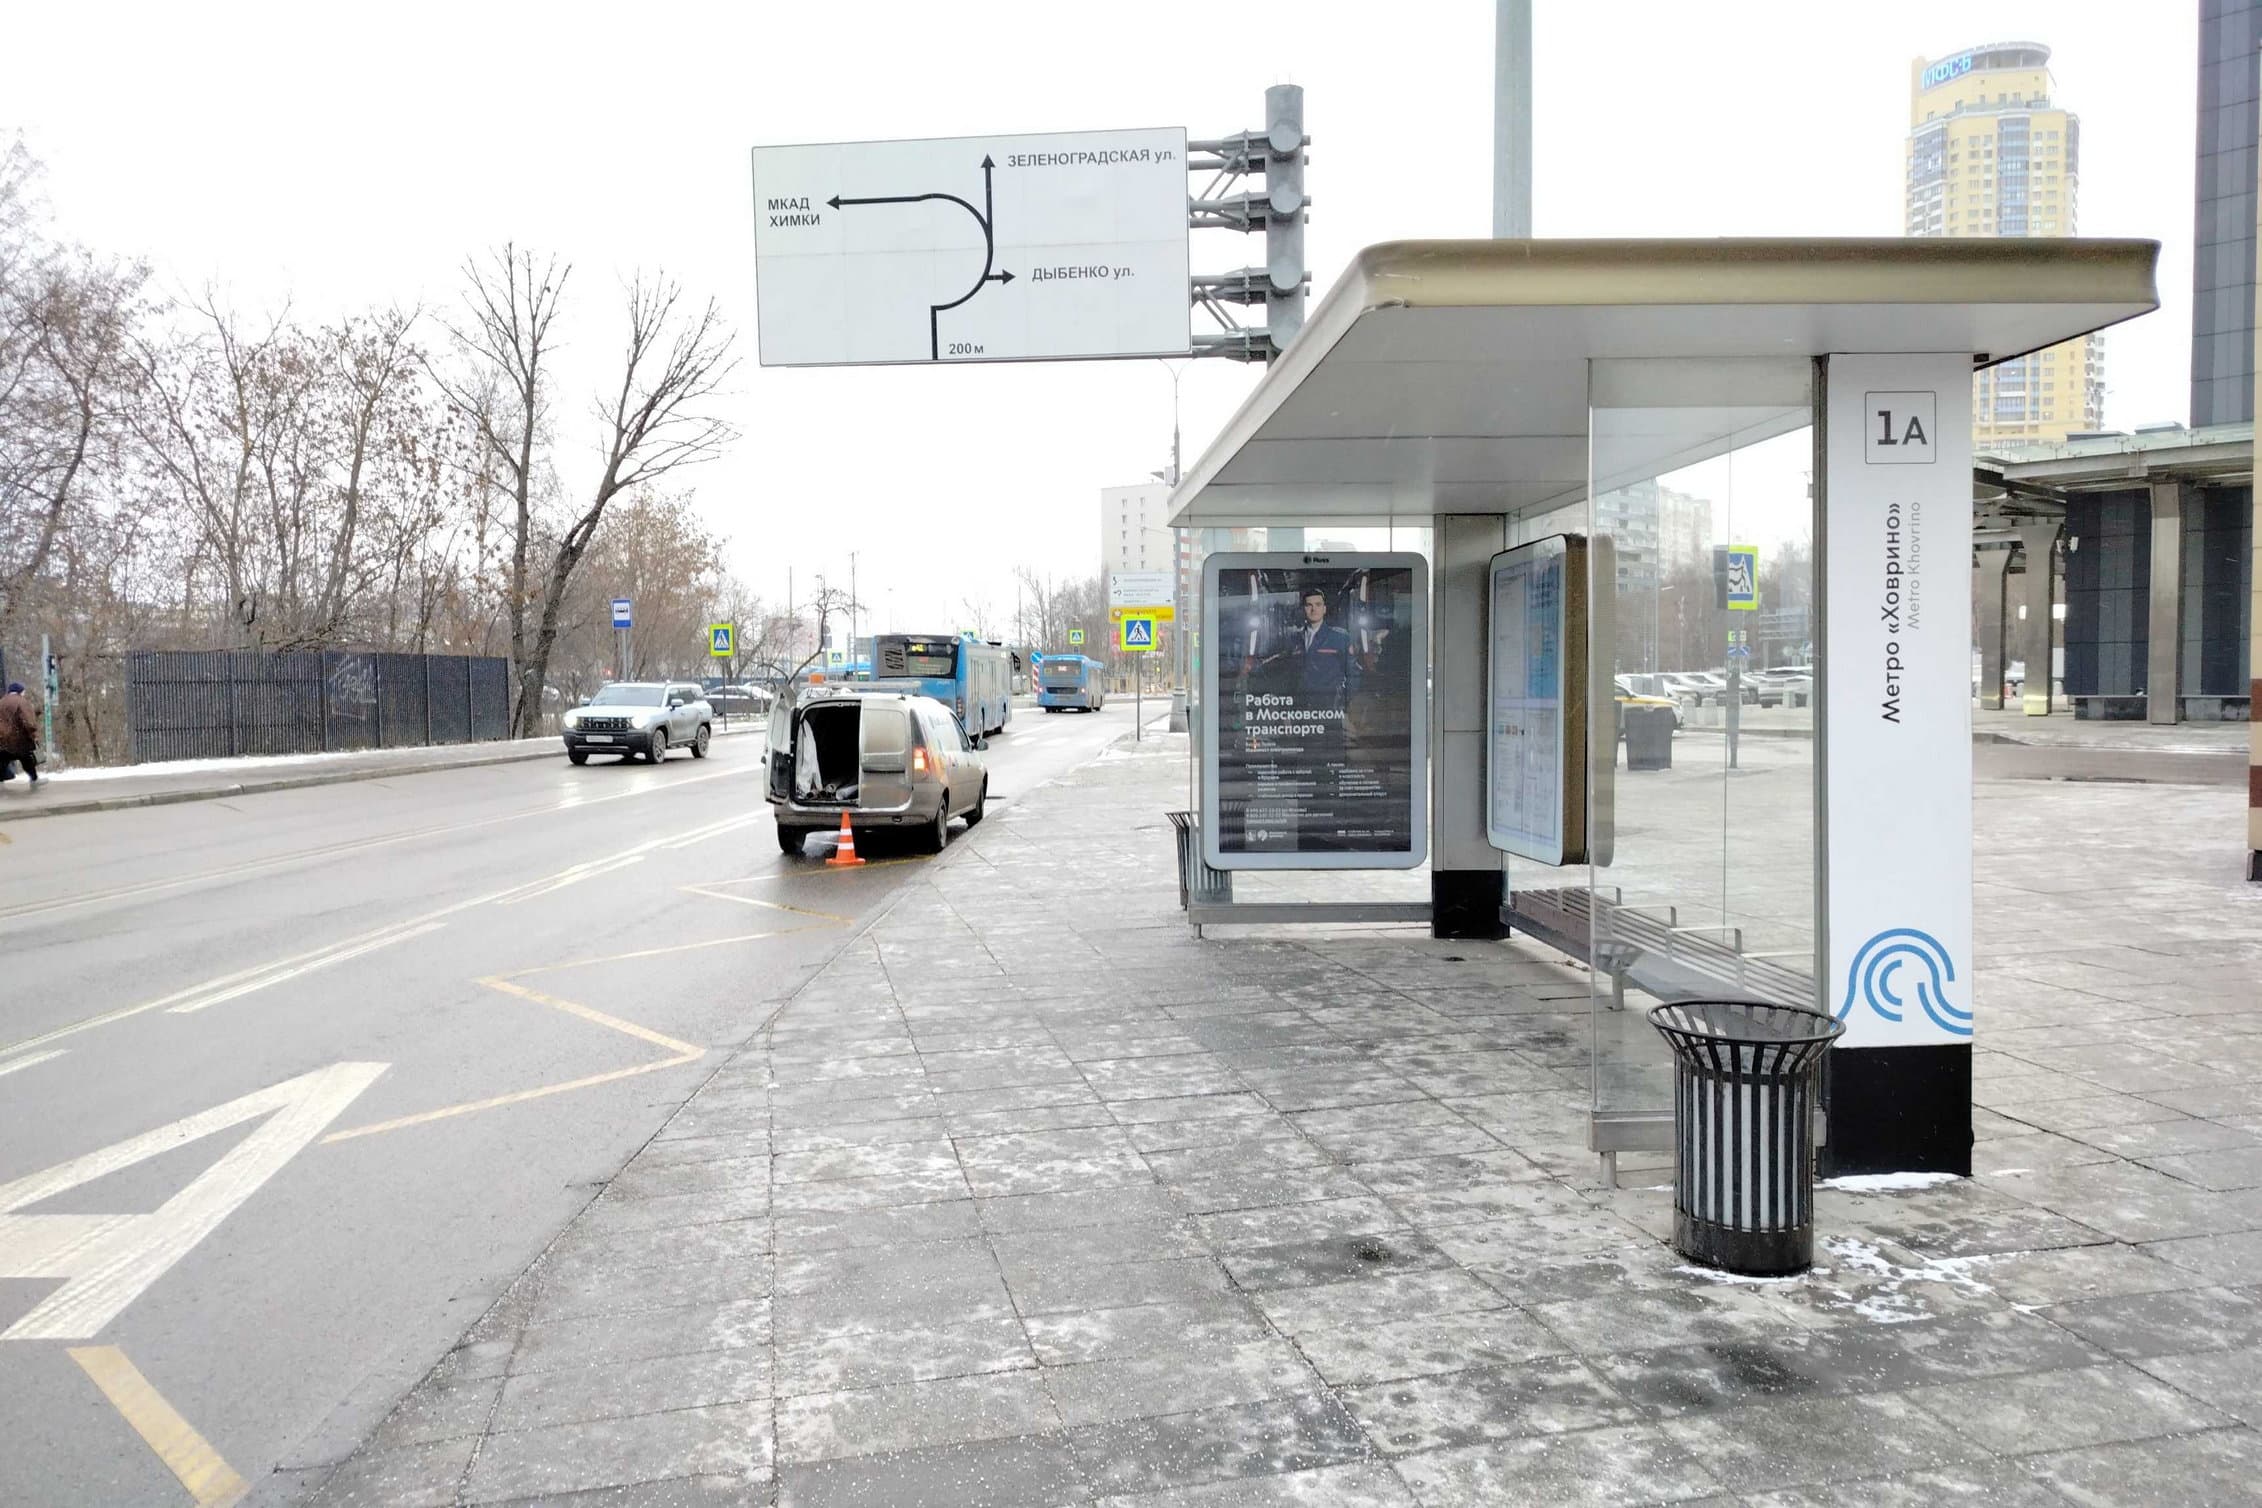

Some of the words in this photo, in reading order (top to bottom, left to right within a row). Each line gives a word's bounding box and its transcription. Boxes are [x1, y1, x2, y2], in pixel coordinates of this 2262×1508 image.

[1007, 149, 1150, 167] ЗЕЛЕНОГРАДСКАЯ
[1154, 152, 1177, 167] ул.
[767, 197, 811, 212] МКАД
[768, 214, 821, 227] ХИМКИ
[1031, 266, 1109, 282] ДЫБЕНКО
[1113, 267, 1135, 281] ул.
[948, 342, 972, 355] 200
[1876, 410, 1928, 446] 1А
[1906, 501, 1921, 574] Khovrino
[1881, 502, 1905, 635] «Ховрино»
[1906, 579, 1921, 630] Metro
[1881, 641, 1905, 724] Метро
[1245, 693, 1294, 706] Работа
[1245, 711, 1254, 721] в
[1256, 708, 1345, 721] Московском
[1245, 724, 1325, 737] транспорте
